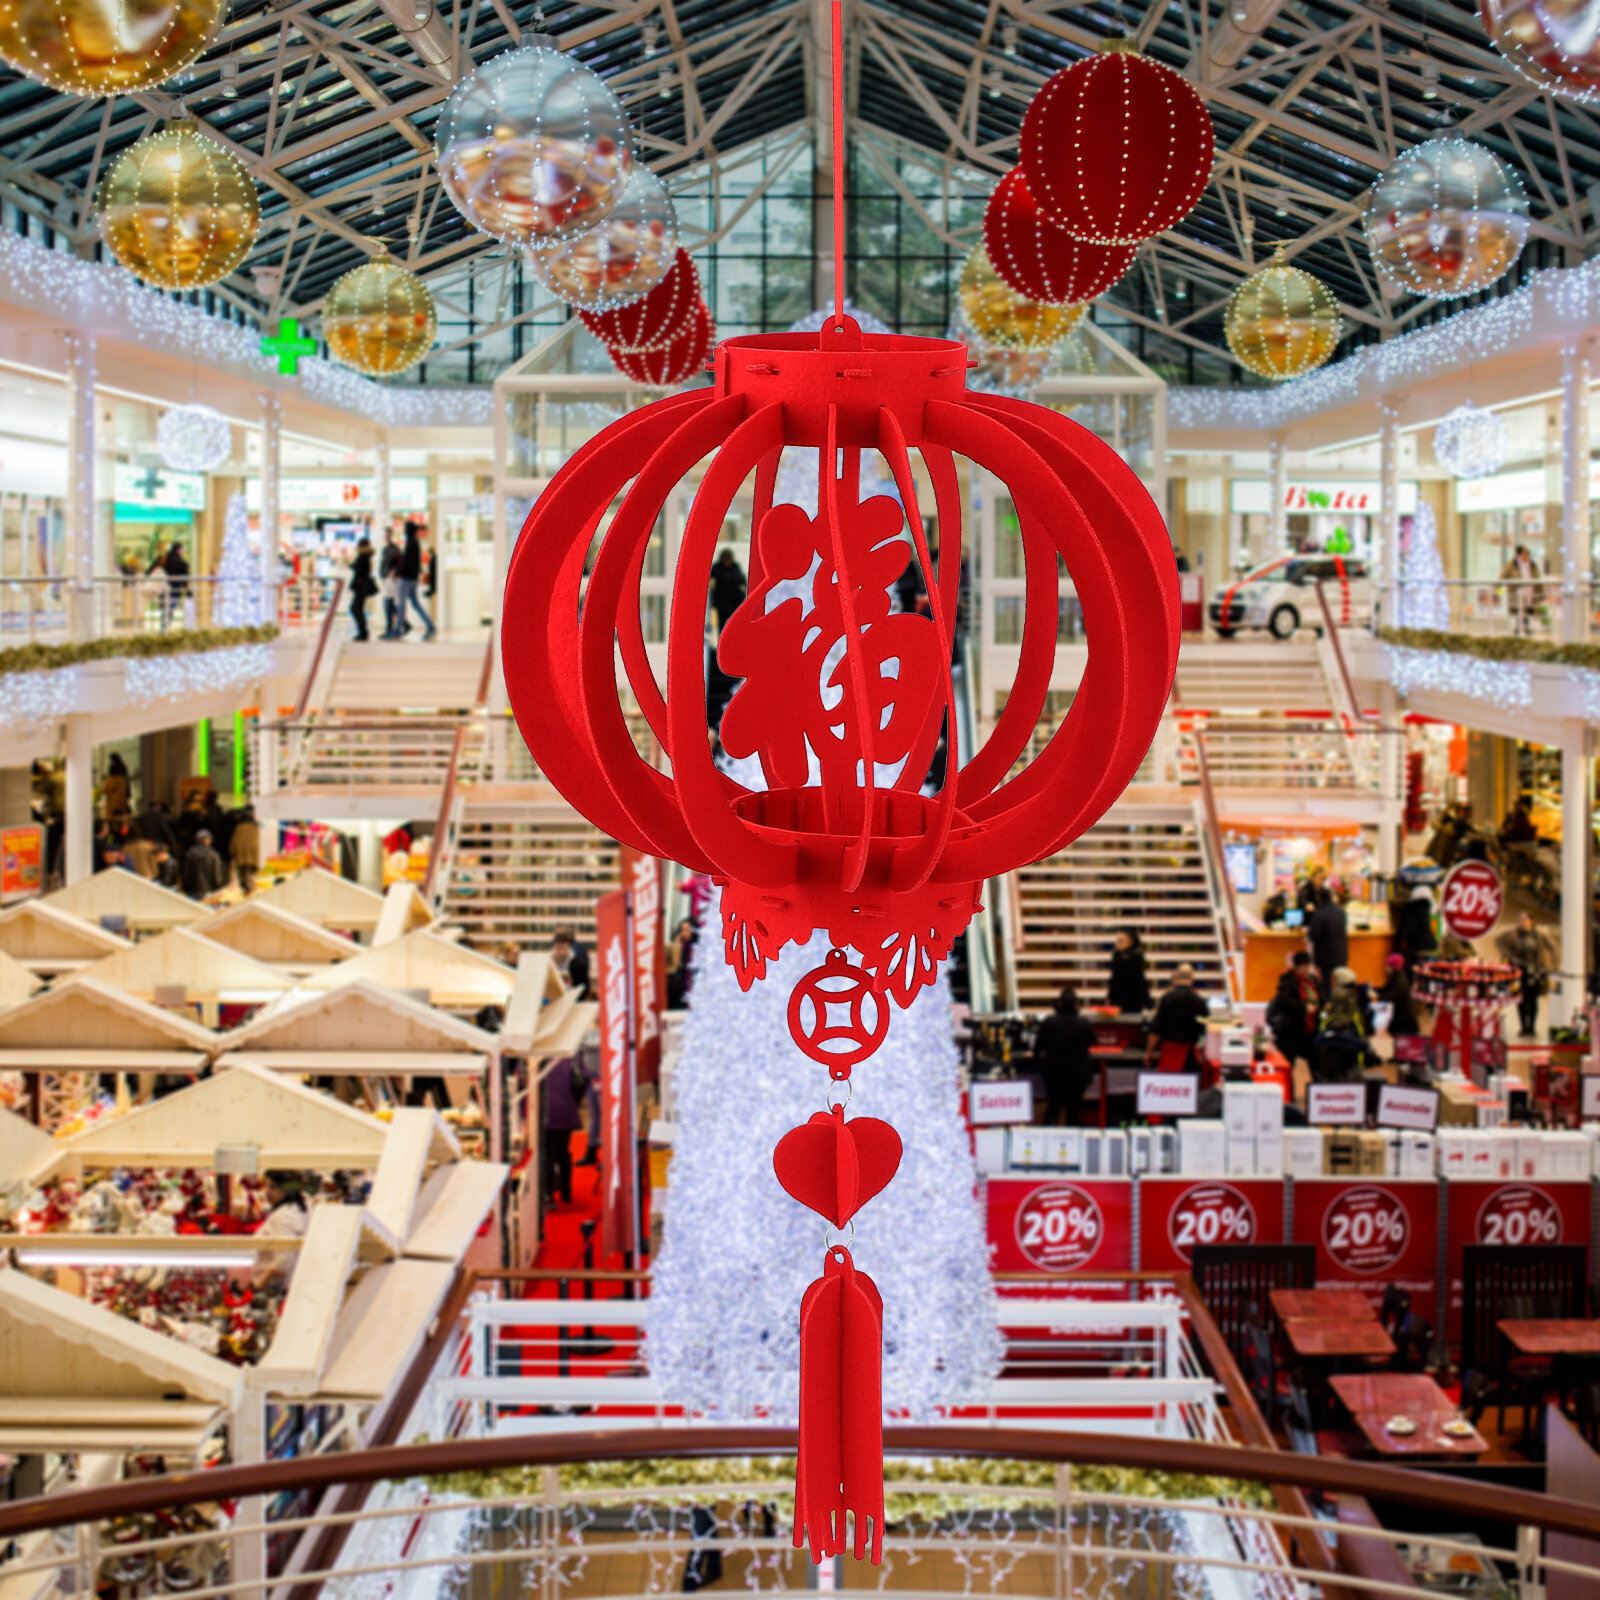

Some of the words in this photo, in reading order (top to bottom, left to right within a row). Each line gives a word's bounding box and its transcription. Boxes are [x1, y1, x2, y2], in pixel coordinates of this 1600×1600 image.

[1445, 881, 1500, 917] 20%
[979, 1094, 1023, 1110] Suisse
[1144, 1082, 1191, 1098] France
[1023, 1204, 1097, 1246] 20%
[1176, 1203, 1250, 1246] 20%
[1330, 1208, 1404, 1249] 20%
[1482, 1206, 1557, 1246] 20%
